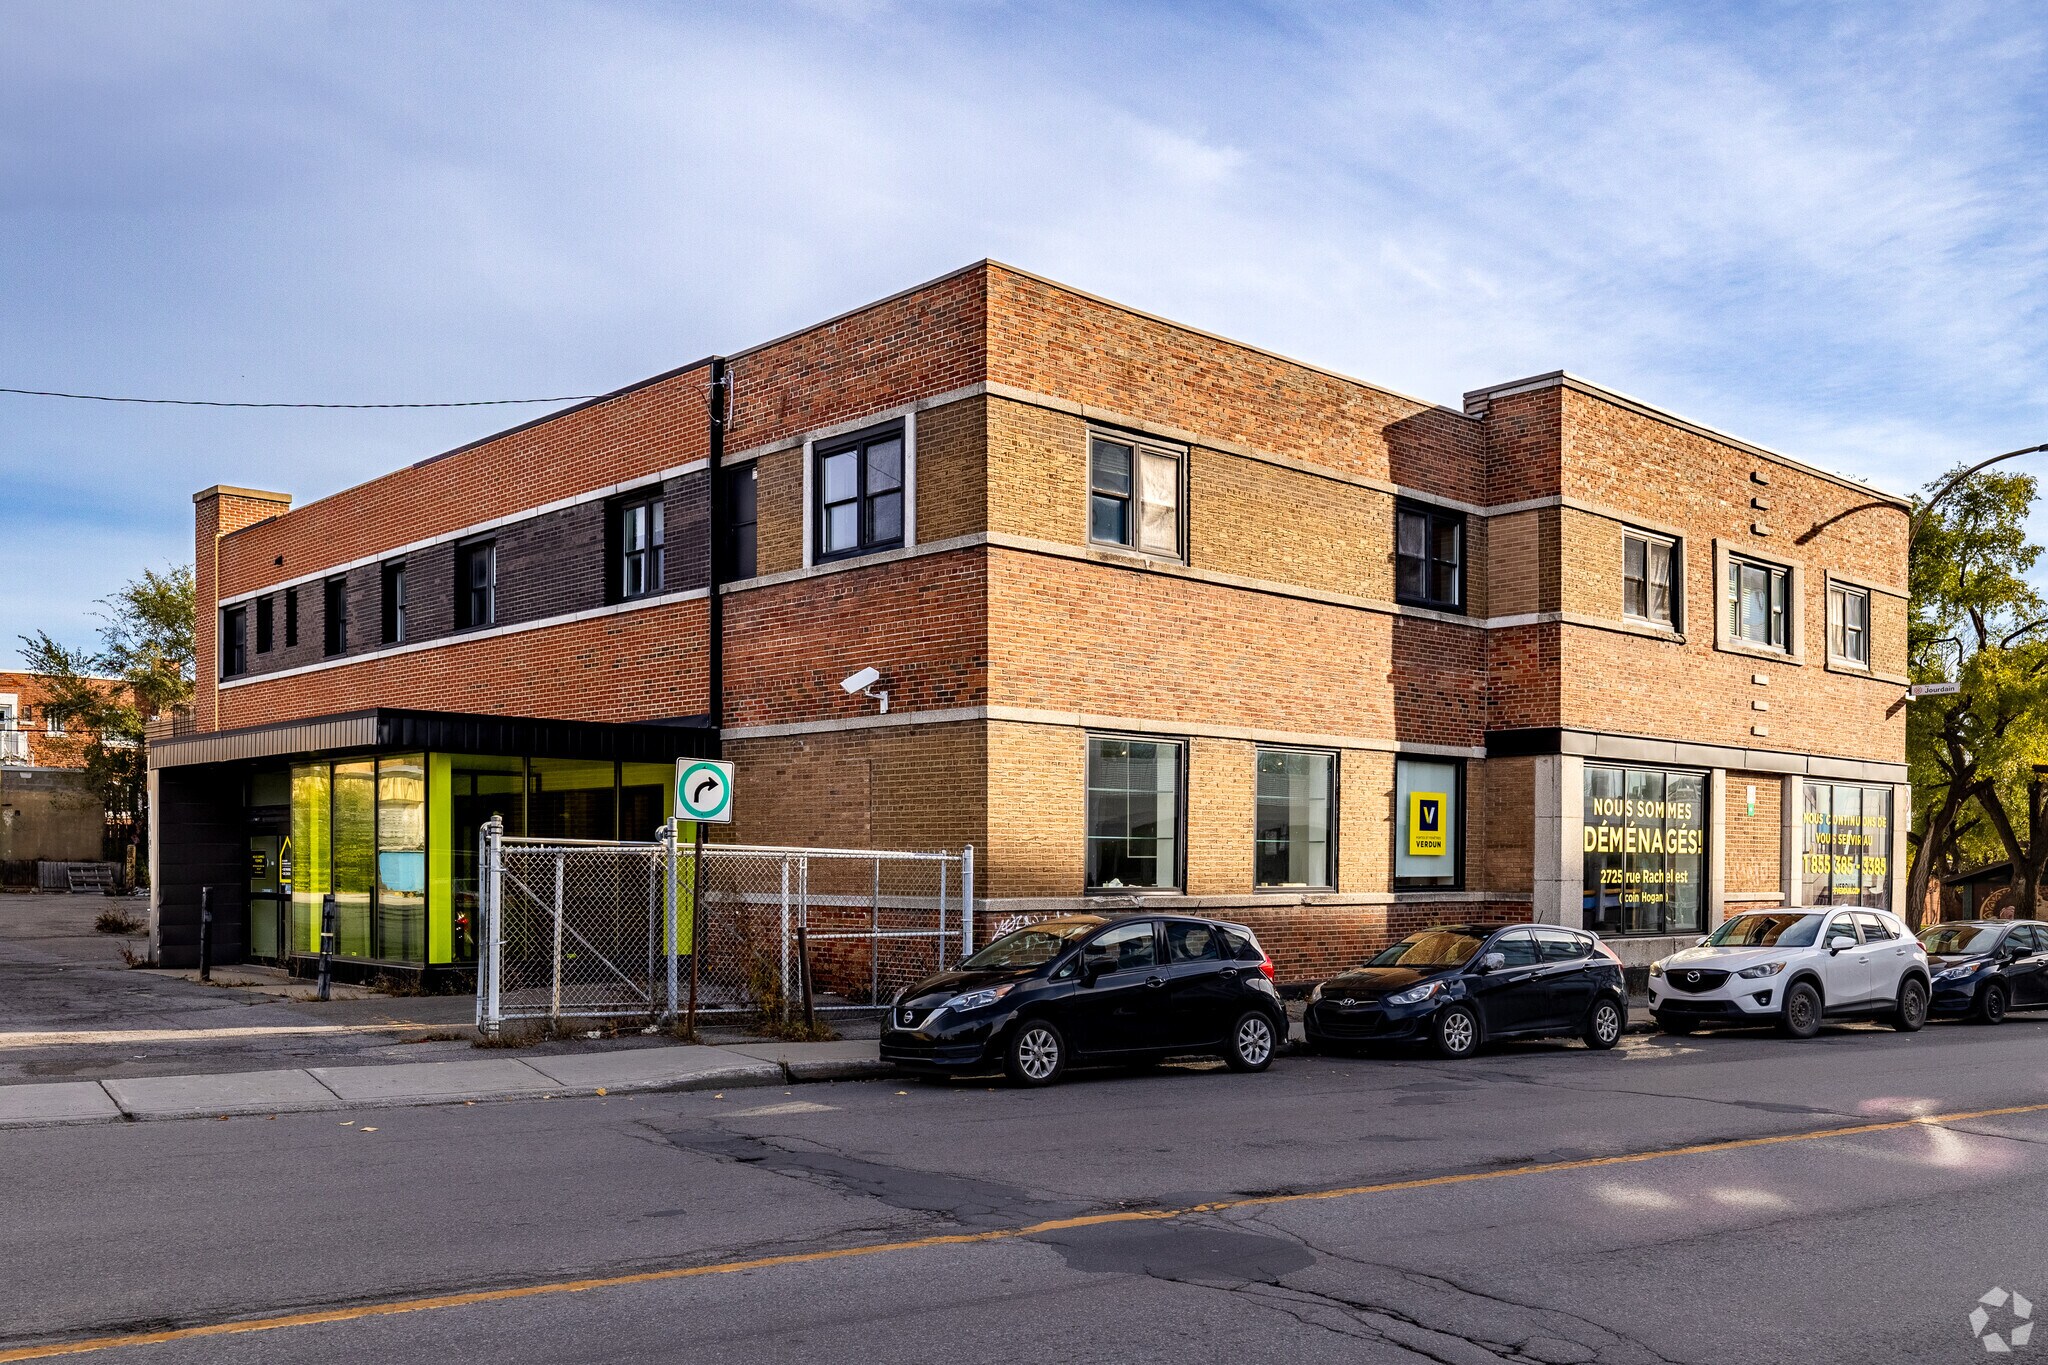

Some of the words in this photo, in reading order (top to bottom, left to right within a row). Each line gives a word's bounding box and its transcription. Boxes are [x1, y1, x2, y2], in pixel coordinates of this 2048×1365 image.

[1423, 806, 1435, 824] V
[1594, 798, 1633, 817] NOUS
[1637, 801, 1692, 819] SOMMES
[1803, 812, 1824, 825] NOUS
[1825, 814, 1876, 828] CONTINUONS
[1877, 816, 1887, 828] DE
[1584, 819, 1702, 854] DÉMÉNAGÉS!
[1815, 832, 1837, 845] VOUS
[1838, 834, 1862, 846] SERVIR
[1863, 835, 1873, 846] AU
[1811, 854, 1831, 874] 855
[1600, 869, 1623, 884] 2725
[1626, 872, 1641, 884] rue
[1643, 869, 1674, 884] Rachel
[1675, 870, 1688, 884] est
